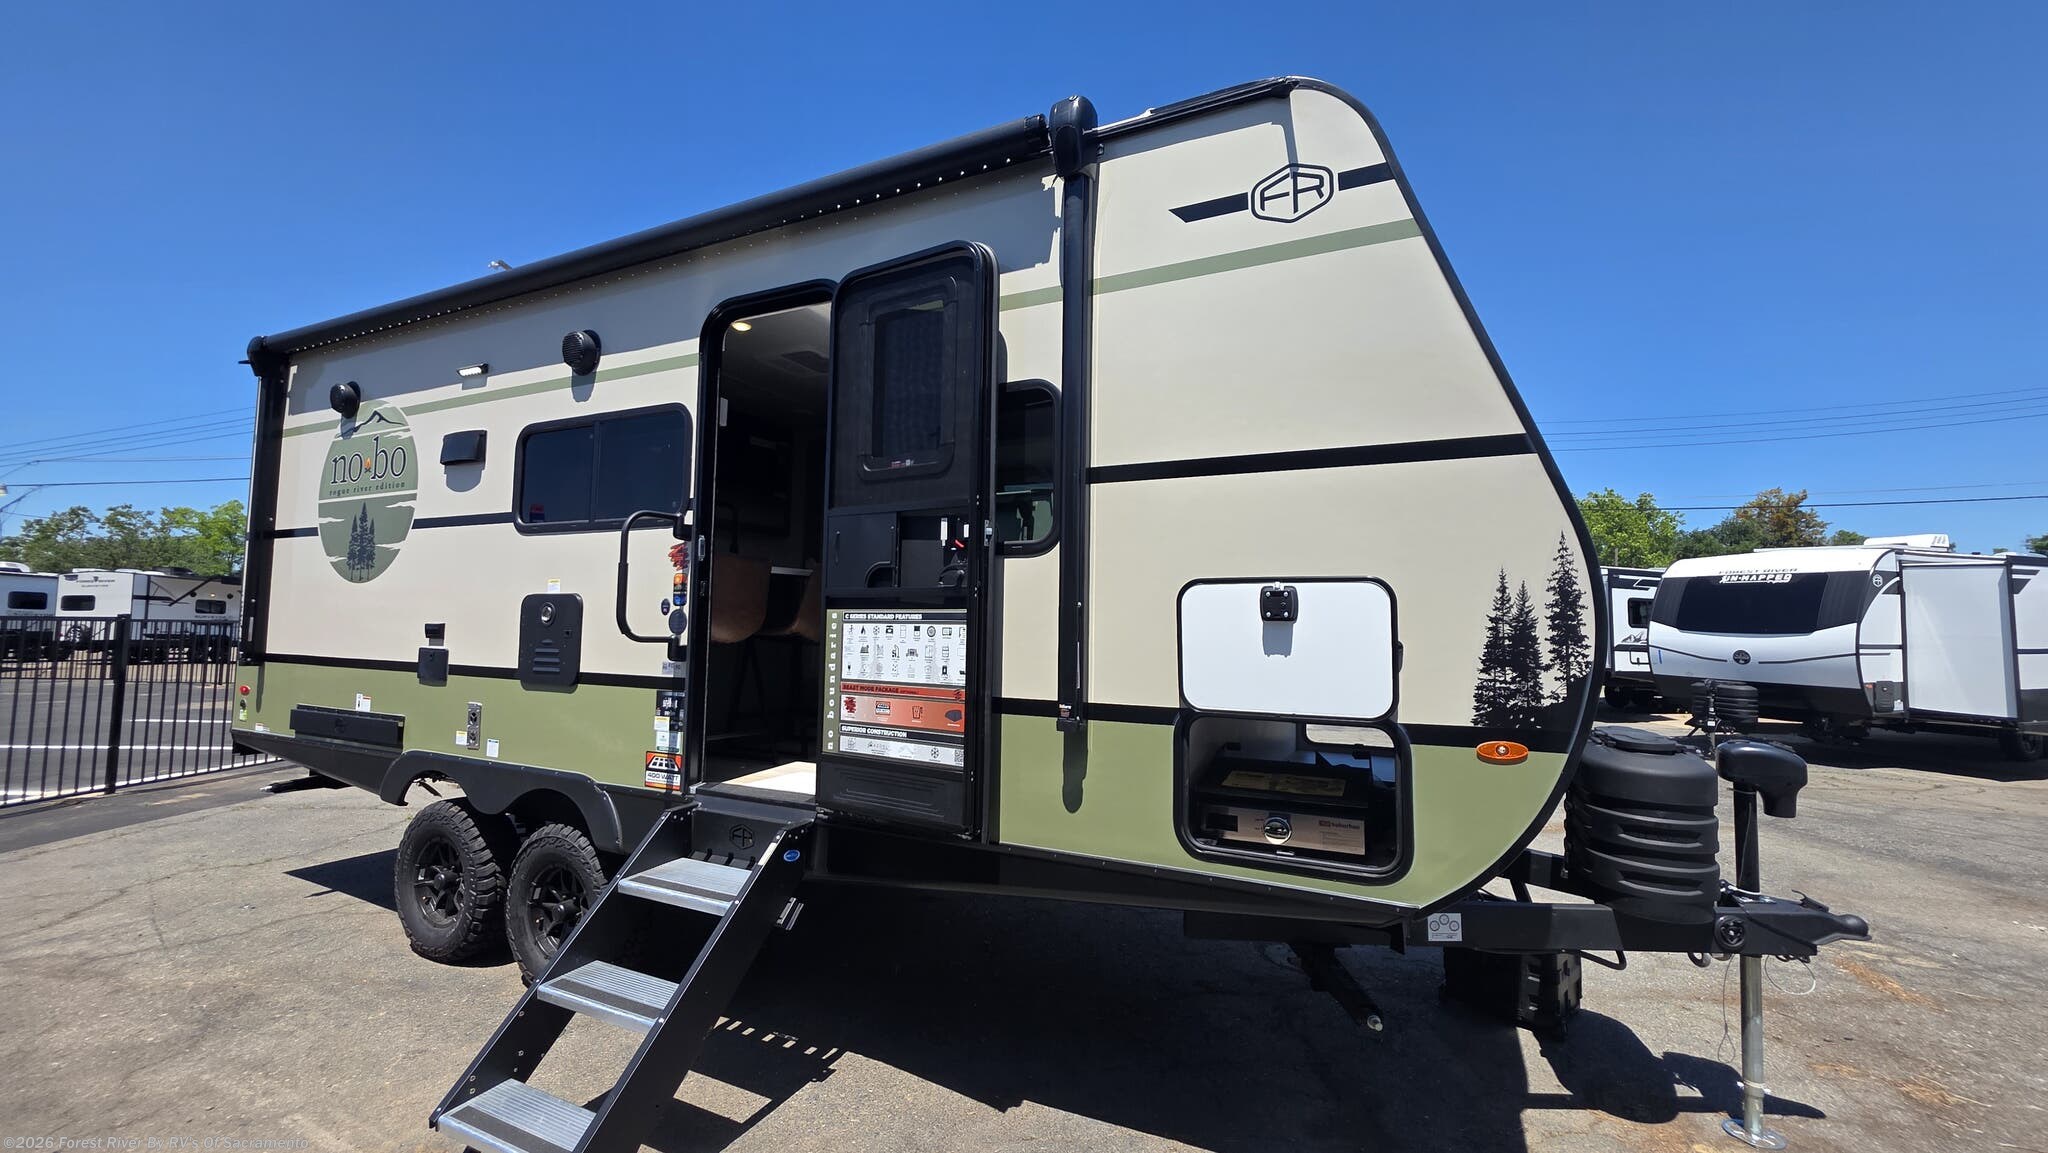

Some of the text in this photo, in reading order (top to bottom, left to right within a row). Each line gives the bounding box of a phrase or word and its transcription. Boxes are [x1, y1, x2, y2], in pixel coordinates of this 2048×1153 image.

[329, 488, 349, 497] rogue
[376, 482, 406, 491] edition
[875, 686, 899, 694] PACKAGE
[841, 725, 908, 738] SUPERIOR CONSTRUCTION
[661, 773, 679, 781] WATT
